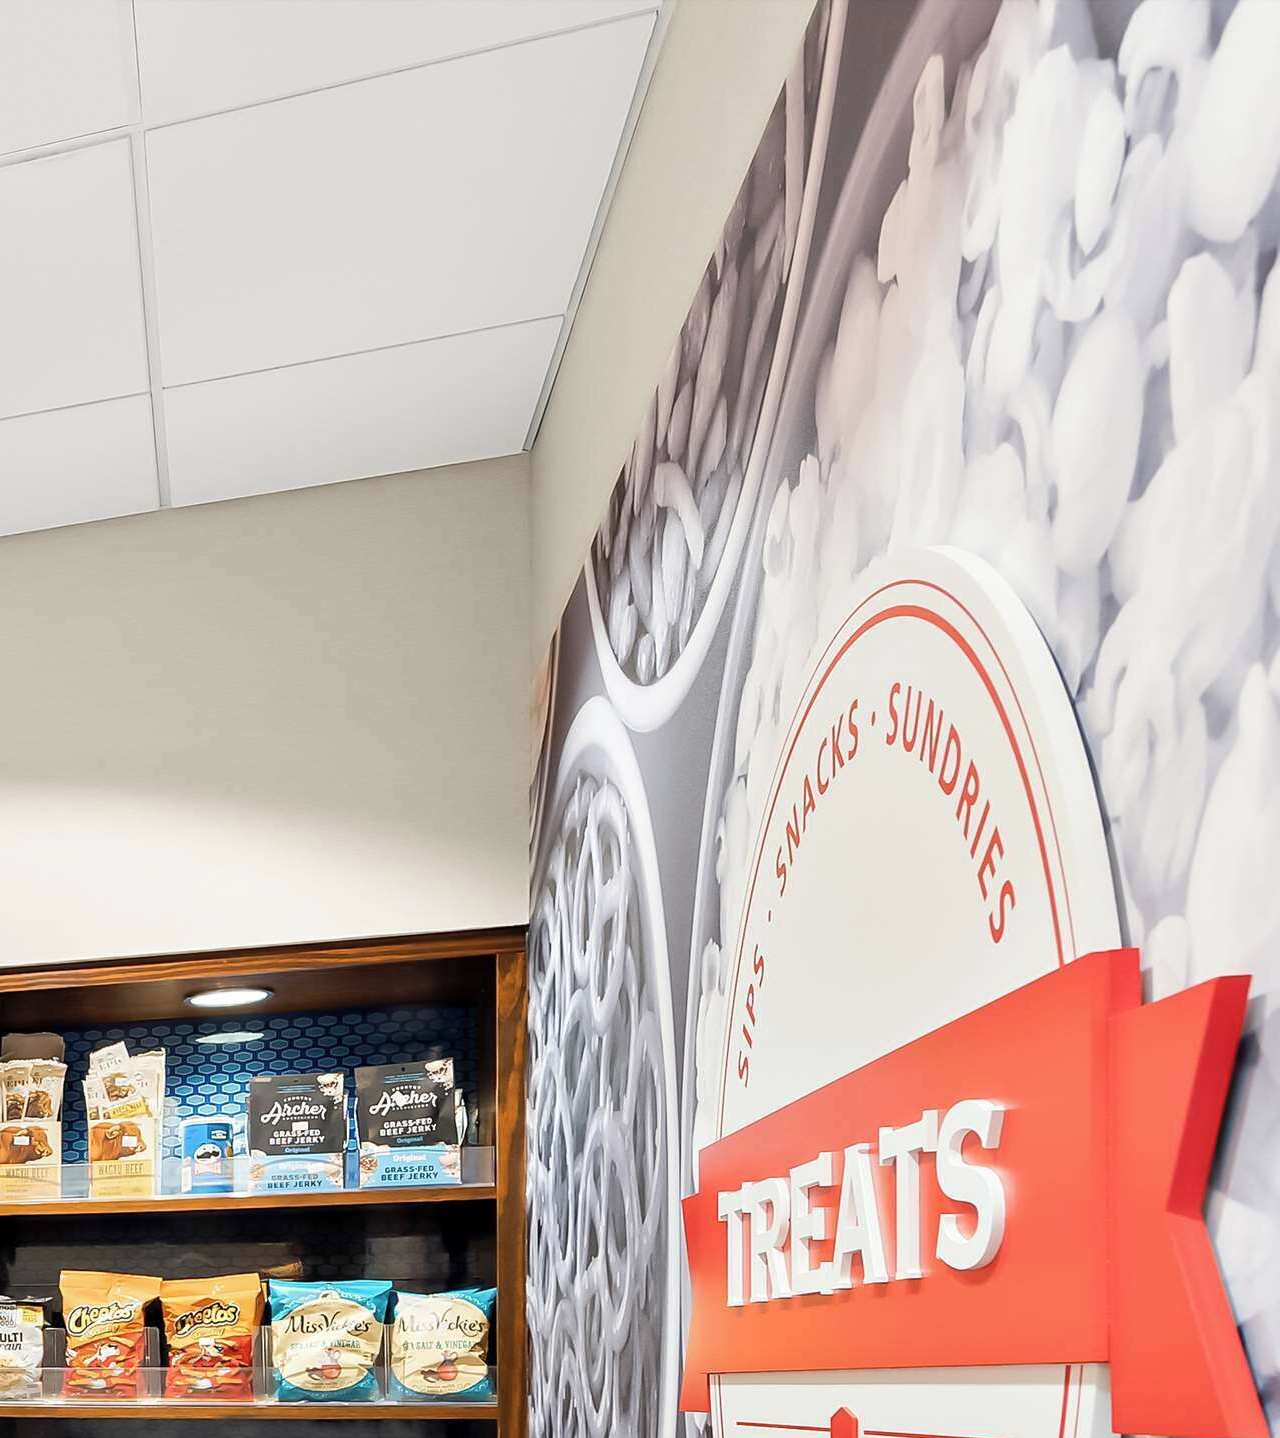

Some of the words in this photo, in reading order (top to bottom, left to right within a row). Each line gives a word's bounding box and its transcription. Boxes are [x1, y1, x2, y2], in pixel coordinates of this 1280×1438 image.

[737, 943, 767, 1088] SIPS
[774, 697, 859, 897] SNACKS
[885, 681, 1017, 943] SUNDRIES
[260, 1100, 328, 1126] Archer
[383, 1117, 433, 1130] GRASS-FED
[272, 1128, 321, 1138] GRASS-FED
[379, 1127, 405, 1137] BEEF
[406, 1123, 437, 1135] JERKY
[269, 1137, 293, 1146] BEEF
[293, 1135, 326, 1145] JERKY
[396, 1136, 424, 1145] Original
[284, 1146, 311, 1154] Original
[392, 1153, 427, 1164] Original
[32, 1167, 50, 1178] BEEF
[97, 1164, 123, 1176] WAGYU
[127, 1163, 144, 1176] BEEF
[384, 1165, 435, 1174] GRASS-FED
[271, 1173, 319, 1182] GRASS-FED
[381, 1172, 406, 1182] BEEF
[407, 1170, 439, 1181] JERKY
[267, 1181, 292, 1190] BEEF
[293, 1180, 323, 1189] JERKY
[717, 1099, 1007, 1308] TREATS
[67, 1302, 135, 1331] Cheetos
[174, 1302, 240, 1335] Cheetos
[285, 1314, 323, 1335] Miss
